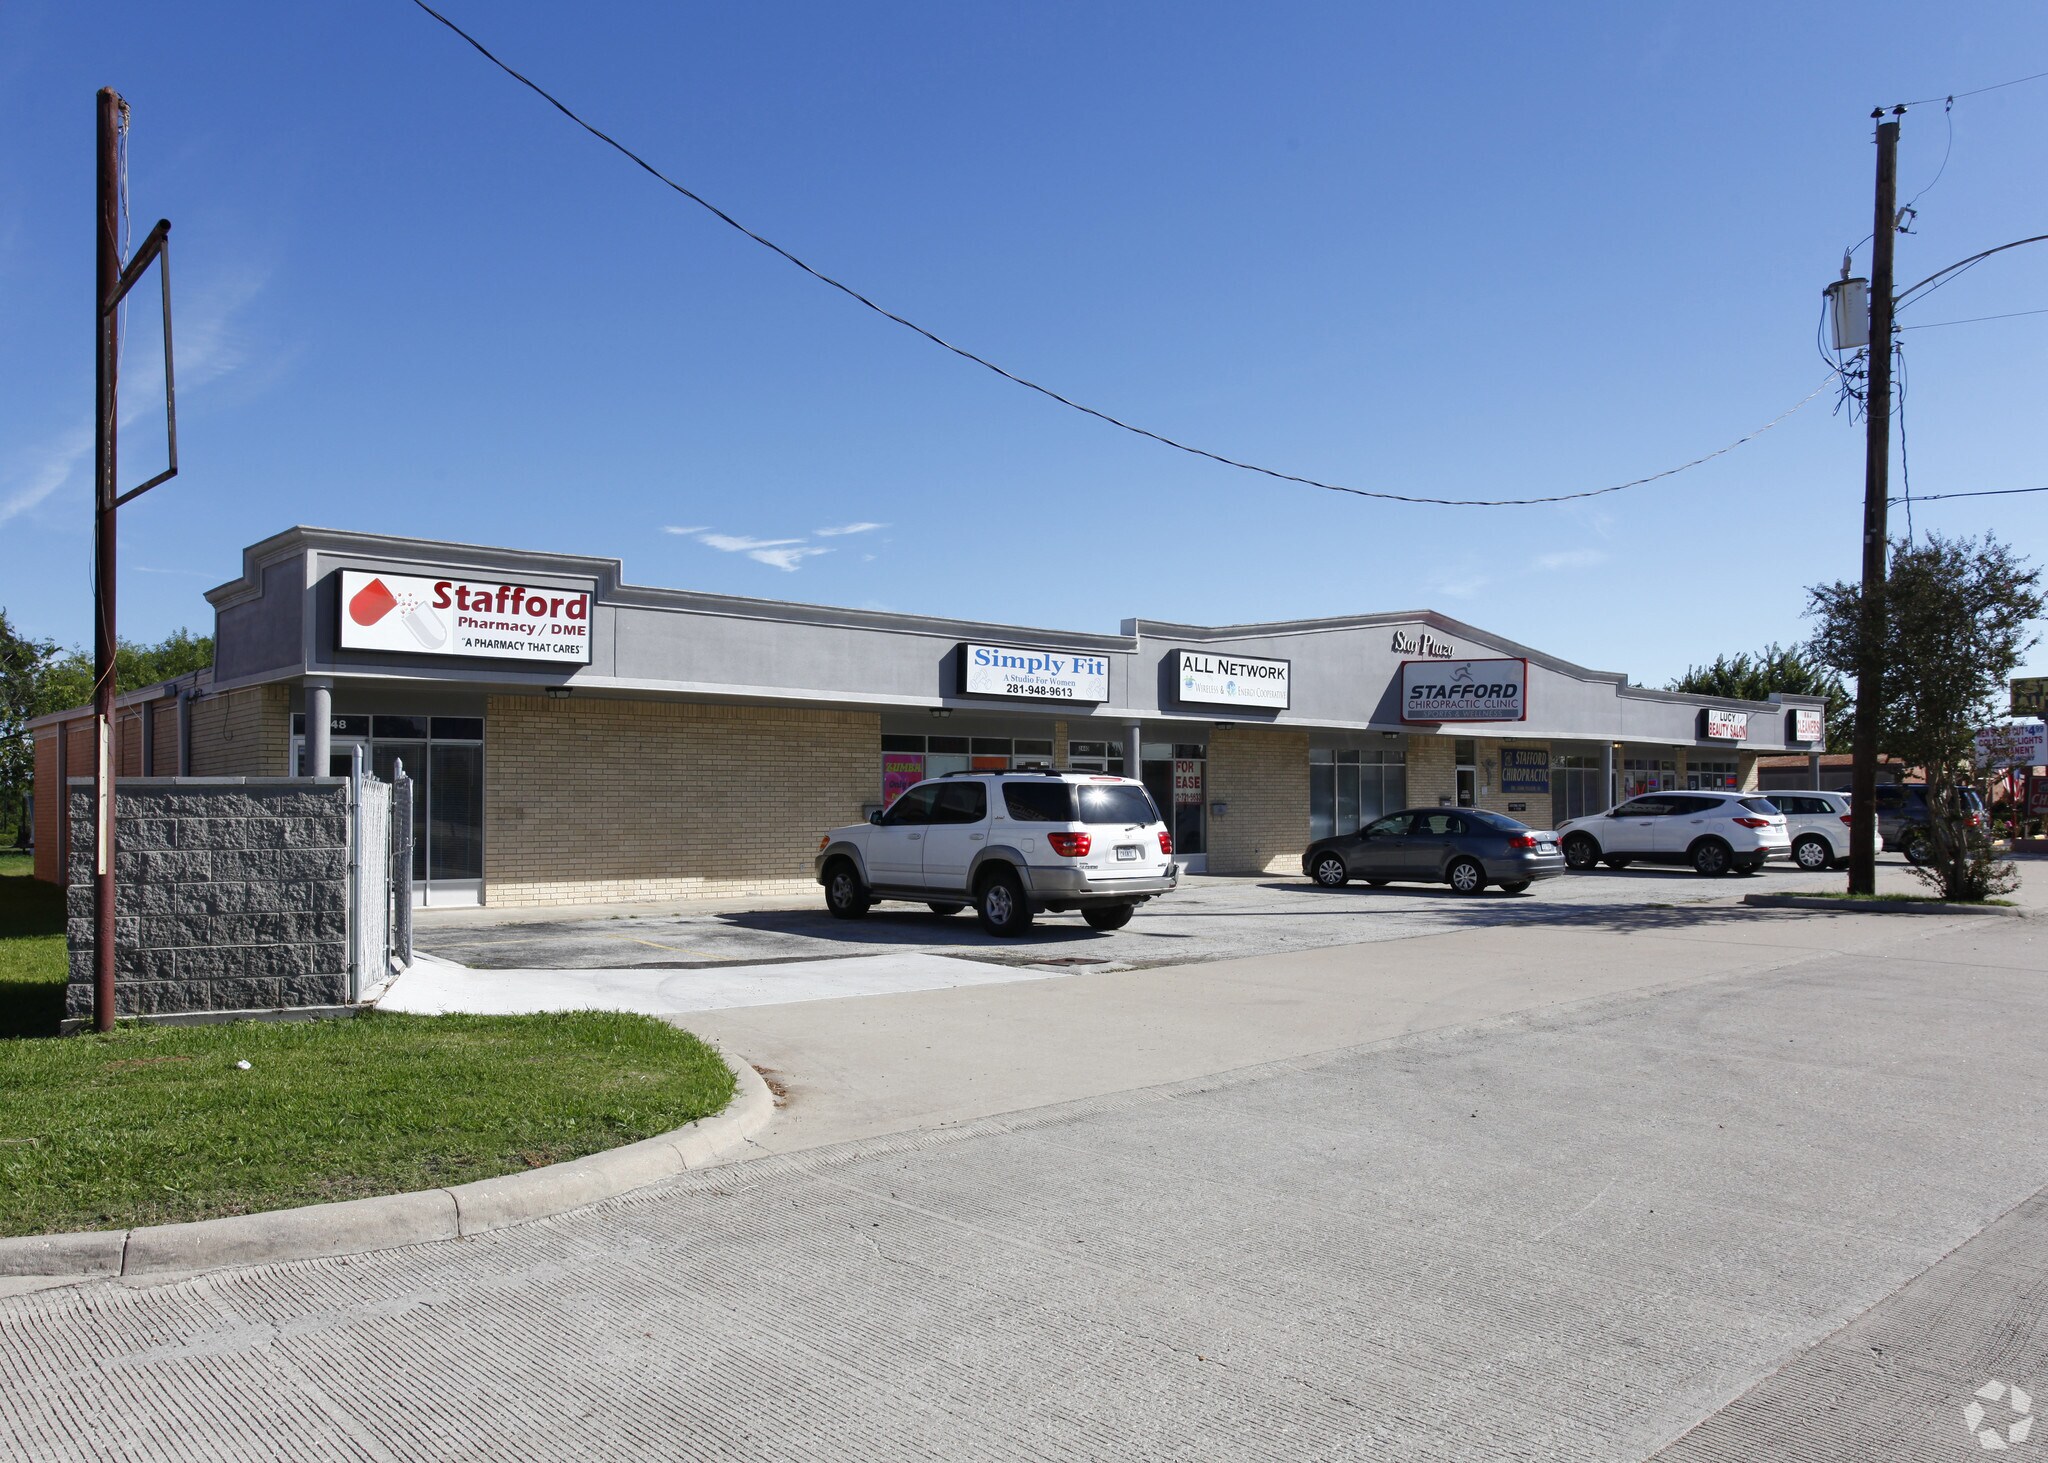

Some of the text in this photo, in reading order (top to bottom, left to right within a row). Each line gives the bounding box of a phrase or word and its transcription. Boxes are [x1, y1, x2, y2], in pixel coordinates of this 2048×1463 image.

[433, 581, 587, 620] Stafford
[458, 616, 536, 636] Pharmacy
[551, 624, 586, 636] DME
[475, 638, 525, 651] PHARMACY
[527, 642, 551, 652] THAT
[1395, 630, 1455, 656] Star Plaza
[975, 648, 1104, 676] Simply Fit
[1183, 656, 1286, 680] ALL NETWORK
[1003, 674, 1010, 682] A
[1011, 675, 1034, 684] Studio
[1049, 678, 1076, 687] Women
[1006, 683, 1073, 697] 281-948-9613
[1220, 685, 1225, 694] &
[1410, 684, 1517, 699] STAFFORD
[1408, 699, 1518, 709] CHIROPRACTIC CLINIC
[1423, 710, 1452, 718] SPORTS
[1462, 709, 1503, 718] WELLNESS
[1720, 712, 1736, 722] LUCY
[1708, 722, 1747, 738] BEAUTY SALON
[1515, 751, 1547, 766] STAFFORD
[886, 762, 922, 773] ZUMBA
[1175, 760, 1194, 773] FOR
[1502, 768, 1549, 782] CHIROPRACTIC
[1175, 776, 1201, 789] EASE
